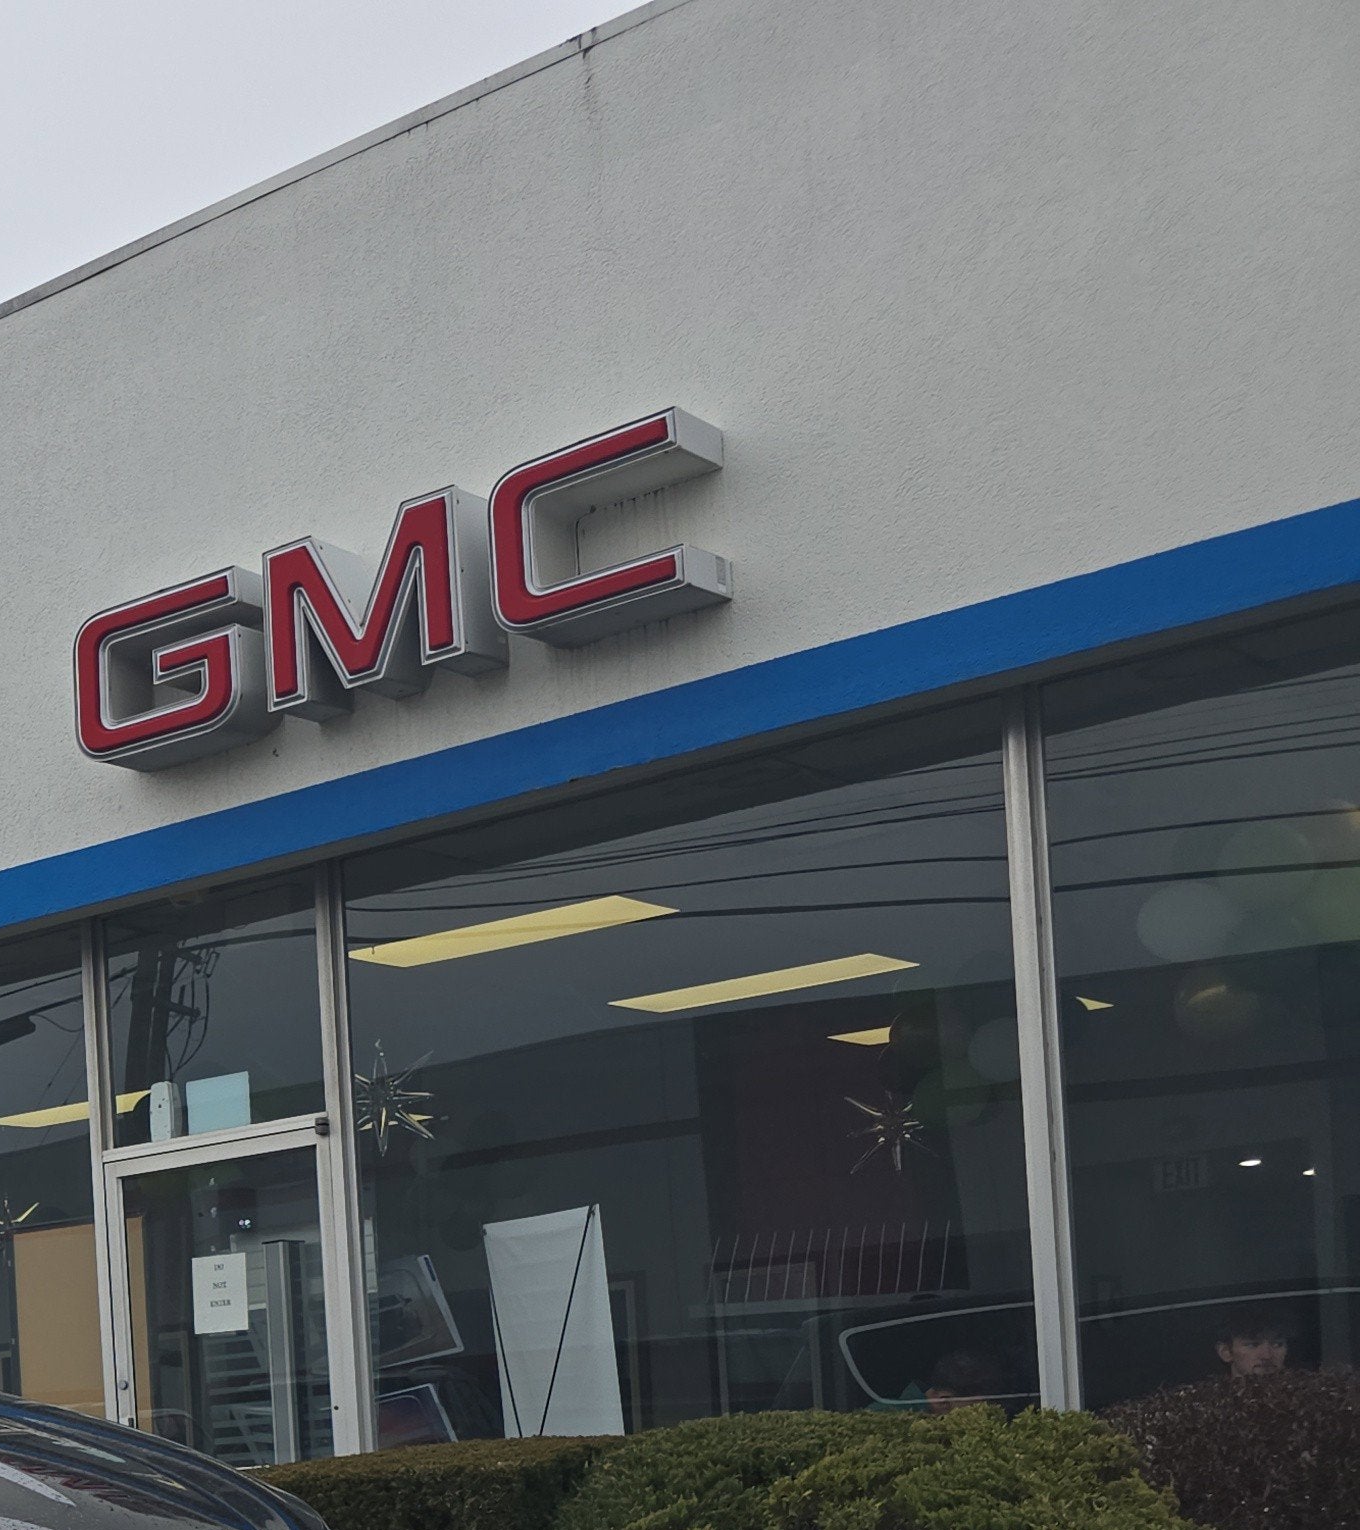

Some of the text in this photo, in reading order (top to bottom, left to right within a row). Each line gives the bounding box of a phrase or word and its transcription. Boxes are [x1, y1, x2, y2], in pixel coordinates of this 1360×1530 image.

[73, 406, 710, 770] GMC
[1162, 1157, 1200, 1189] EXIT
[212, 1281, 227, 1289] NOT
